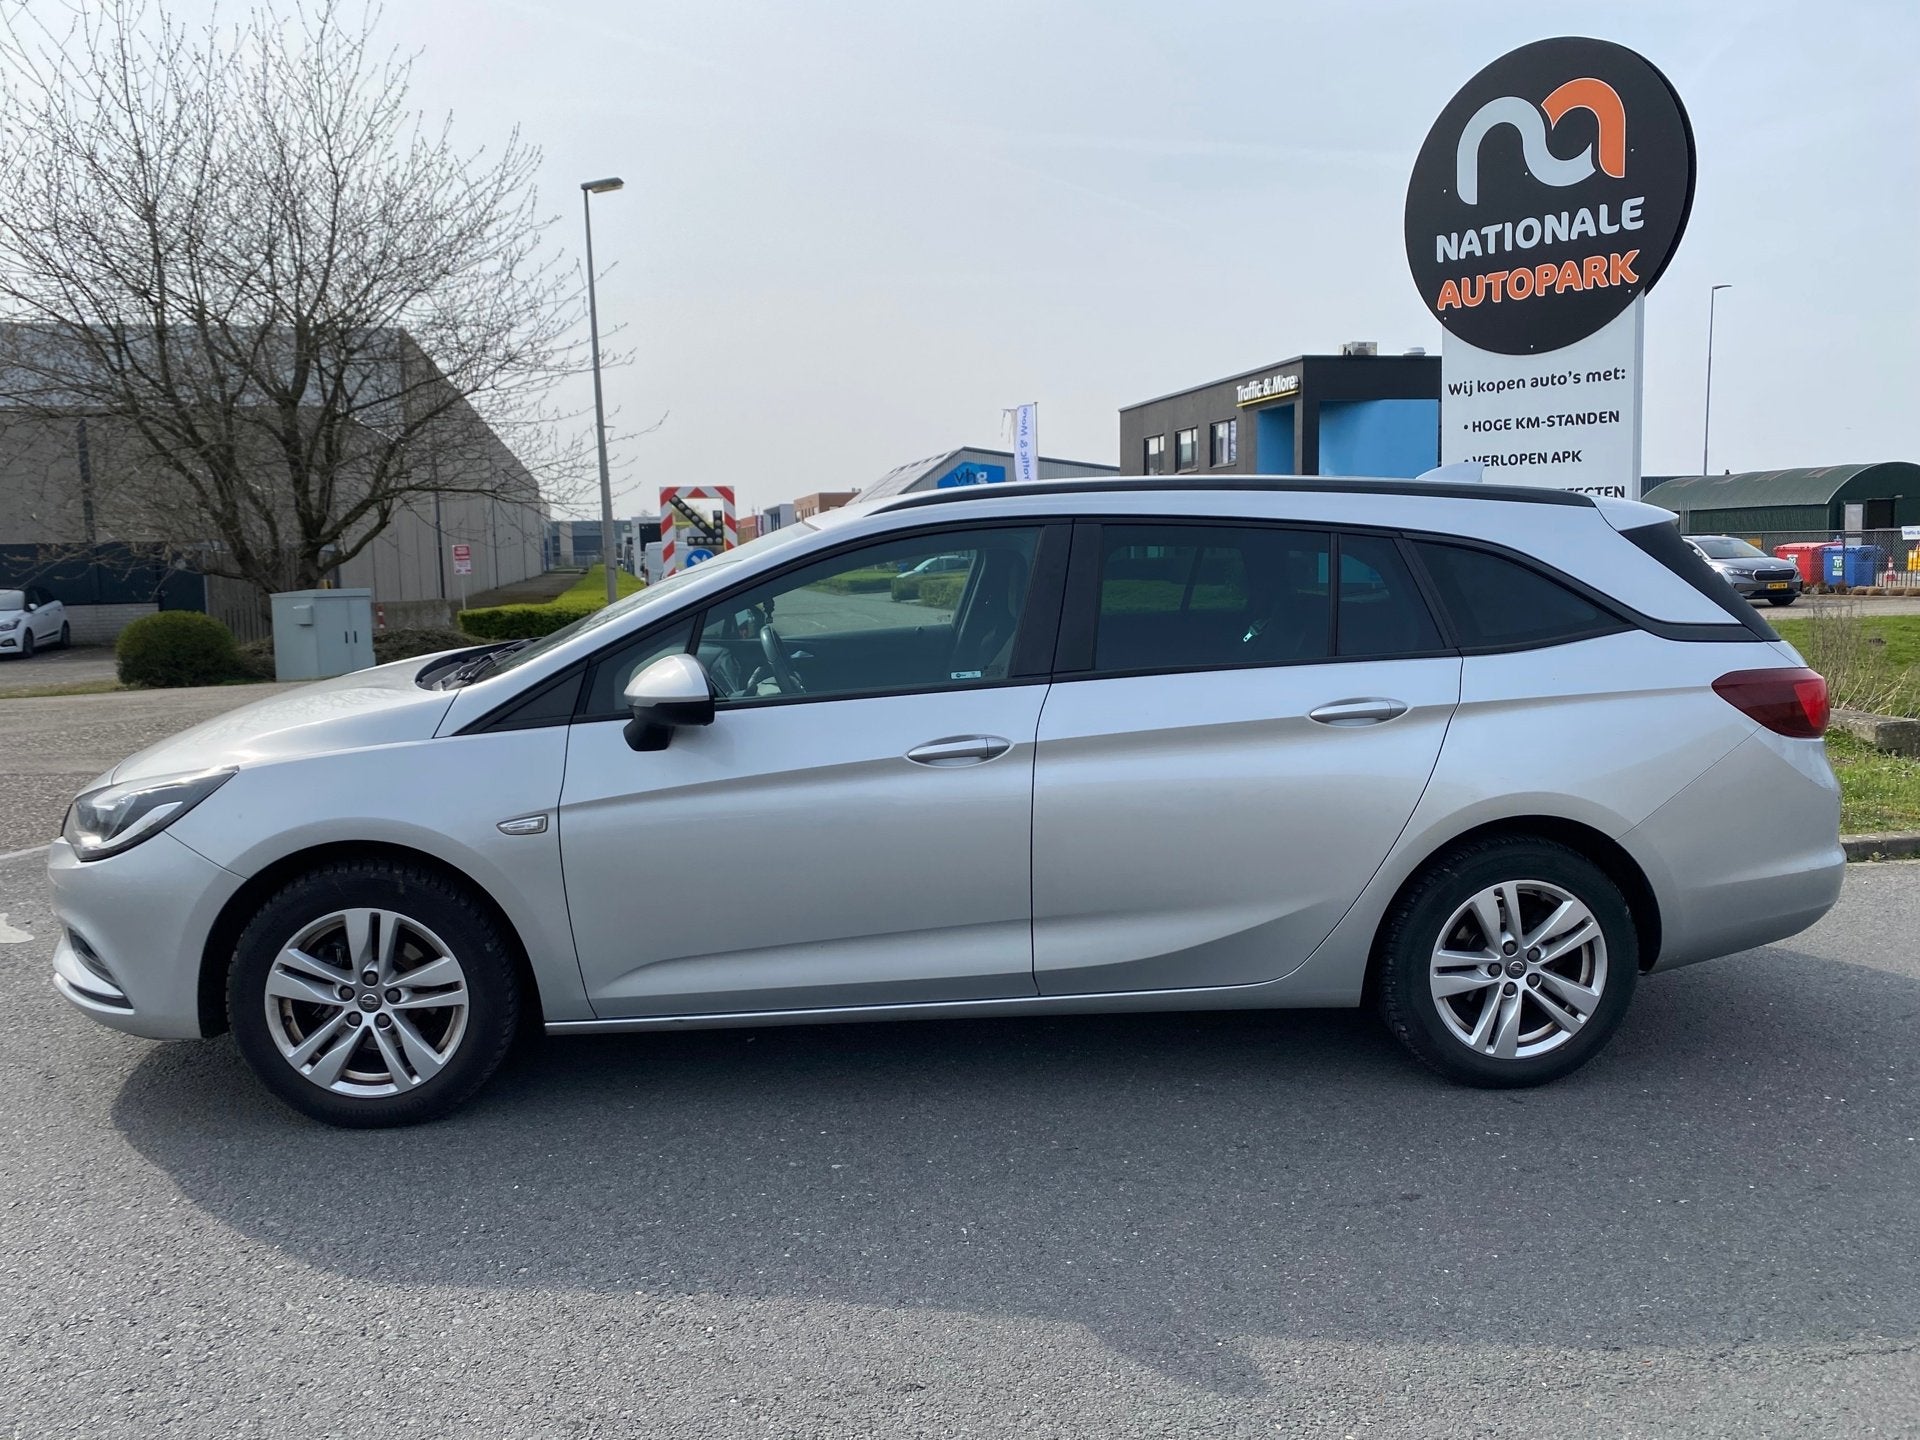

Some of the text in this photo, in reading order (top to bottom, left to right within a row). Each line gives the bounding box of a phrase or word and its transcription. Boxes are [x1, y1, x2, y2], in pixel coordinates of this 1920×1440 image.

[1436, 196, 1645, 263] NATIONALE
[1437, 249, 1640, 310] AUTOPARK
[1236, 375, 1299, 402] Traffic & More
[1448, 367, 1626, 397] Wij kopen auto's met:
[1472, 410, 1620, 433] HOGE KM-STANDEN
[1551, 450, 1582, 464] APK
[954, 468, 988, 484] vhg
